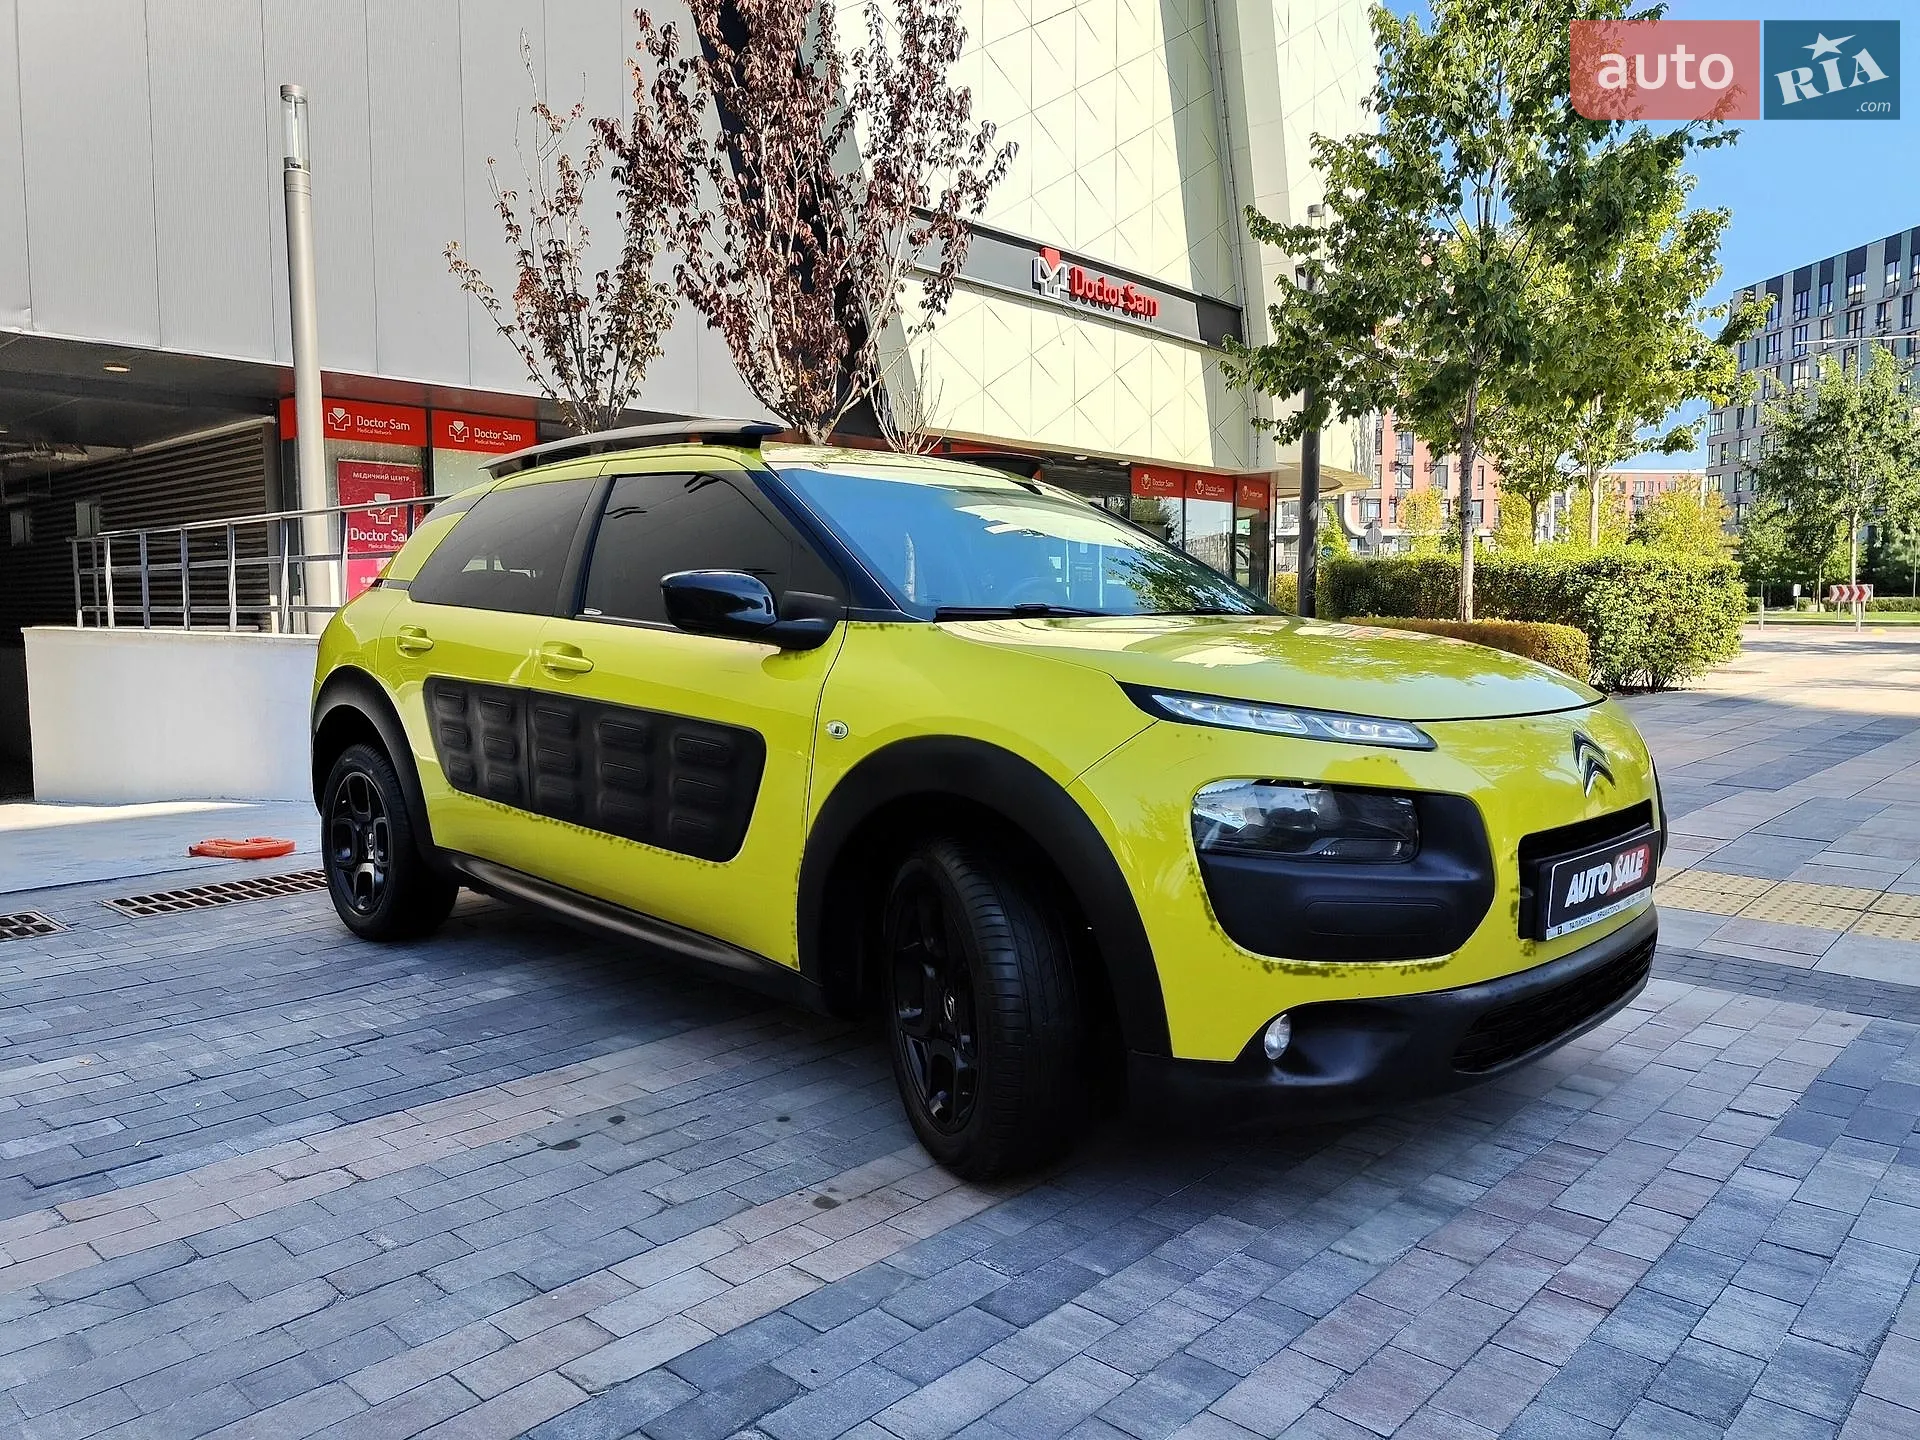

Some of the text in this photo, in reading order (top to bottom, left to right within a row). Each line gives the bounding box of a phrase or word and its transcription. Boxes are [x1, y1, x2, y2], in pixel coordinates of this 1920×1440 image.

[1069, 265, 1159, 317] Doctor Sam
[356, 415, 410, 431] Doctor Sam
[474, 427, 521, 442] Doctor Sam
[352, 471, 390, 481] МЕДИЧНИЙ
[350, 527, 389, 541] Doctor
[1564, 848, 1645, 908] AUTO SALE
